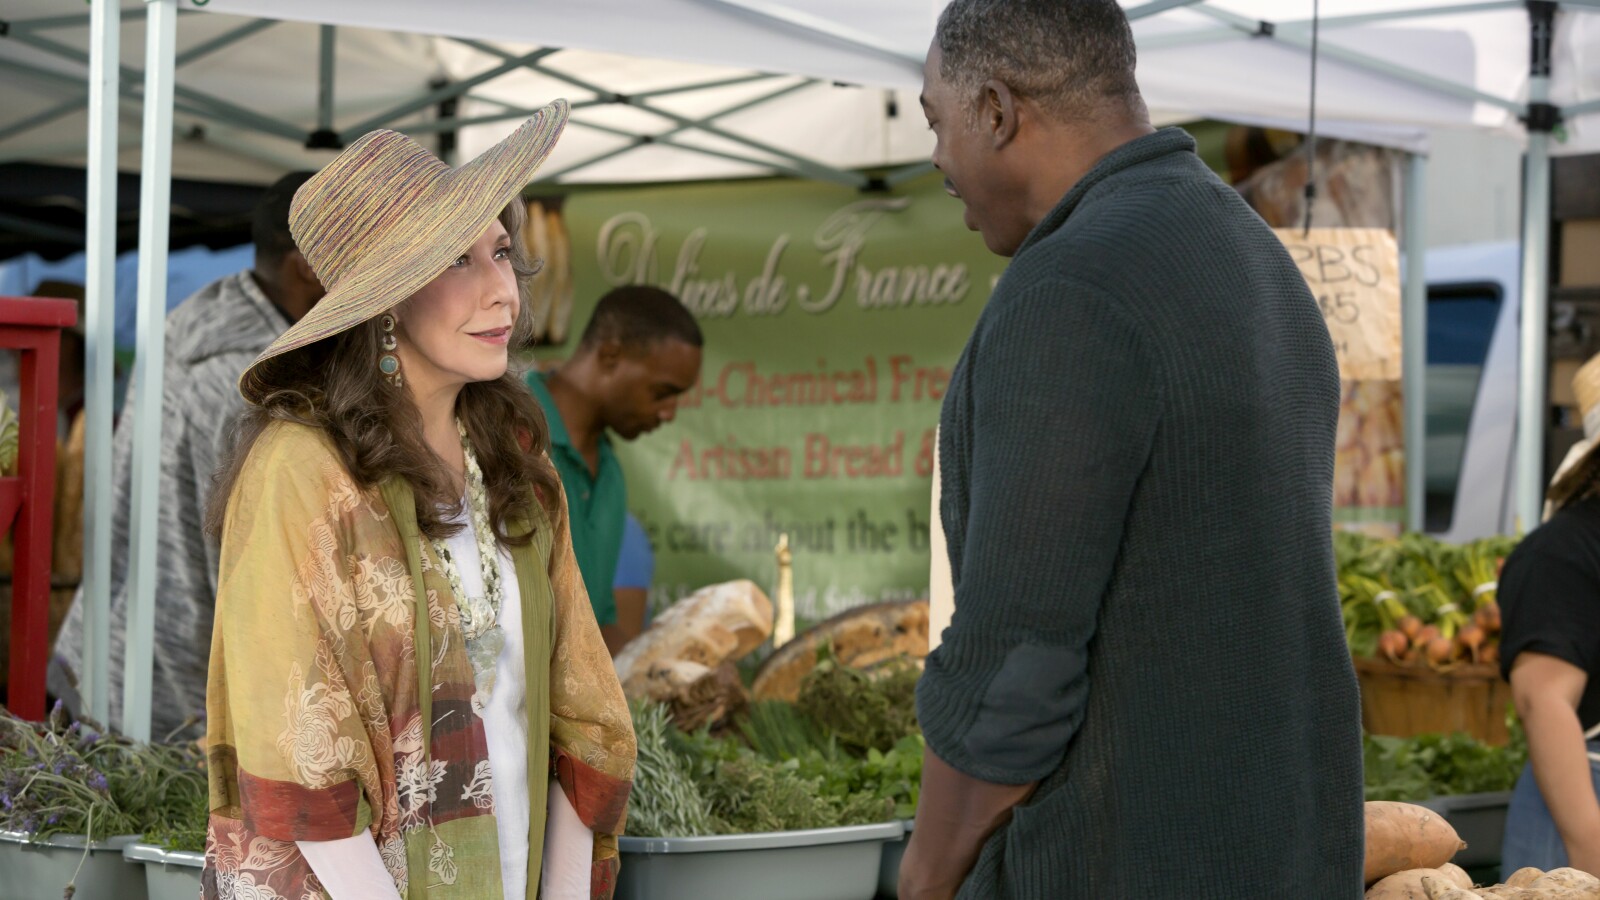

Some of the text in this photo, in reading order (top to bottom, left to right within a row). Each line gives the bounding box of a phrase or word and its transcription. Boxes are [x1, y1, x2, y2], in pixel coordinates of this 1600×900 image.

[743, 233, 790, 316] de
[797, 197, 970, 315] France
[1286, 244, 1380, 287] RBS
[888, 354, 950, 402] Fre
[668, 435, 792, 481] Artisan
[803, 429, 904, 479] Bread
[741, 508, 835, 554] about
[847, 508, 898, 554] the
[906, 507, 931, 555] b
